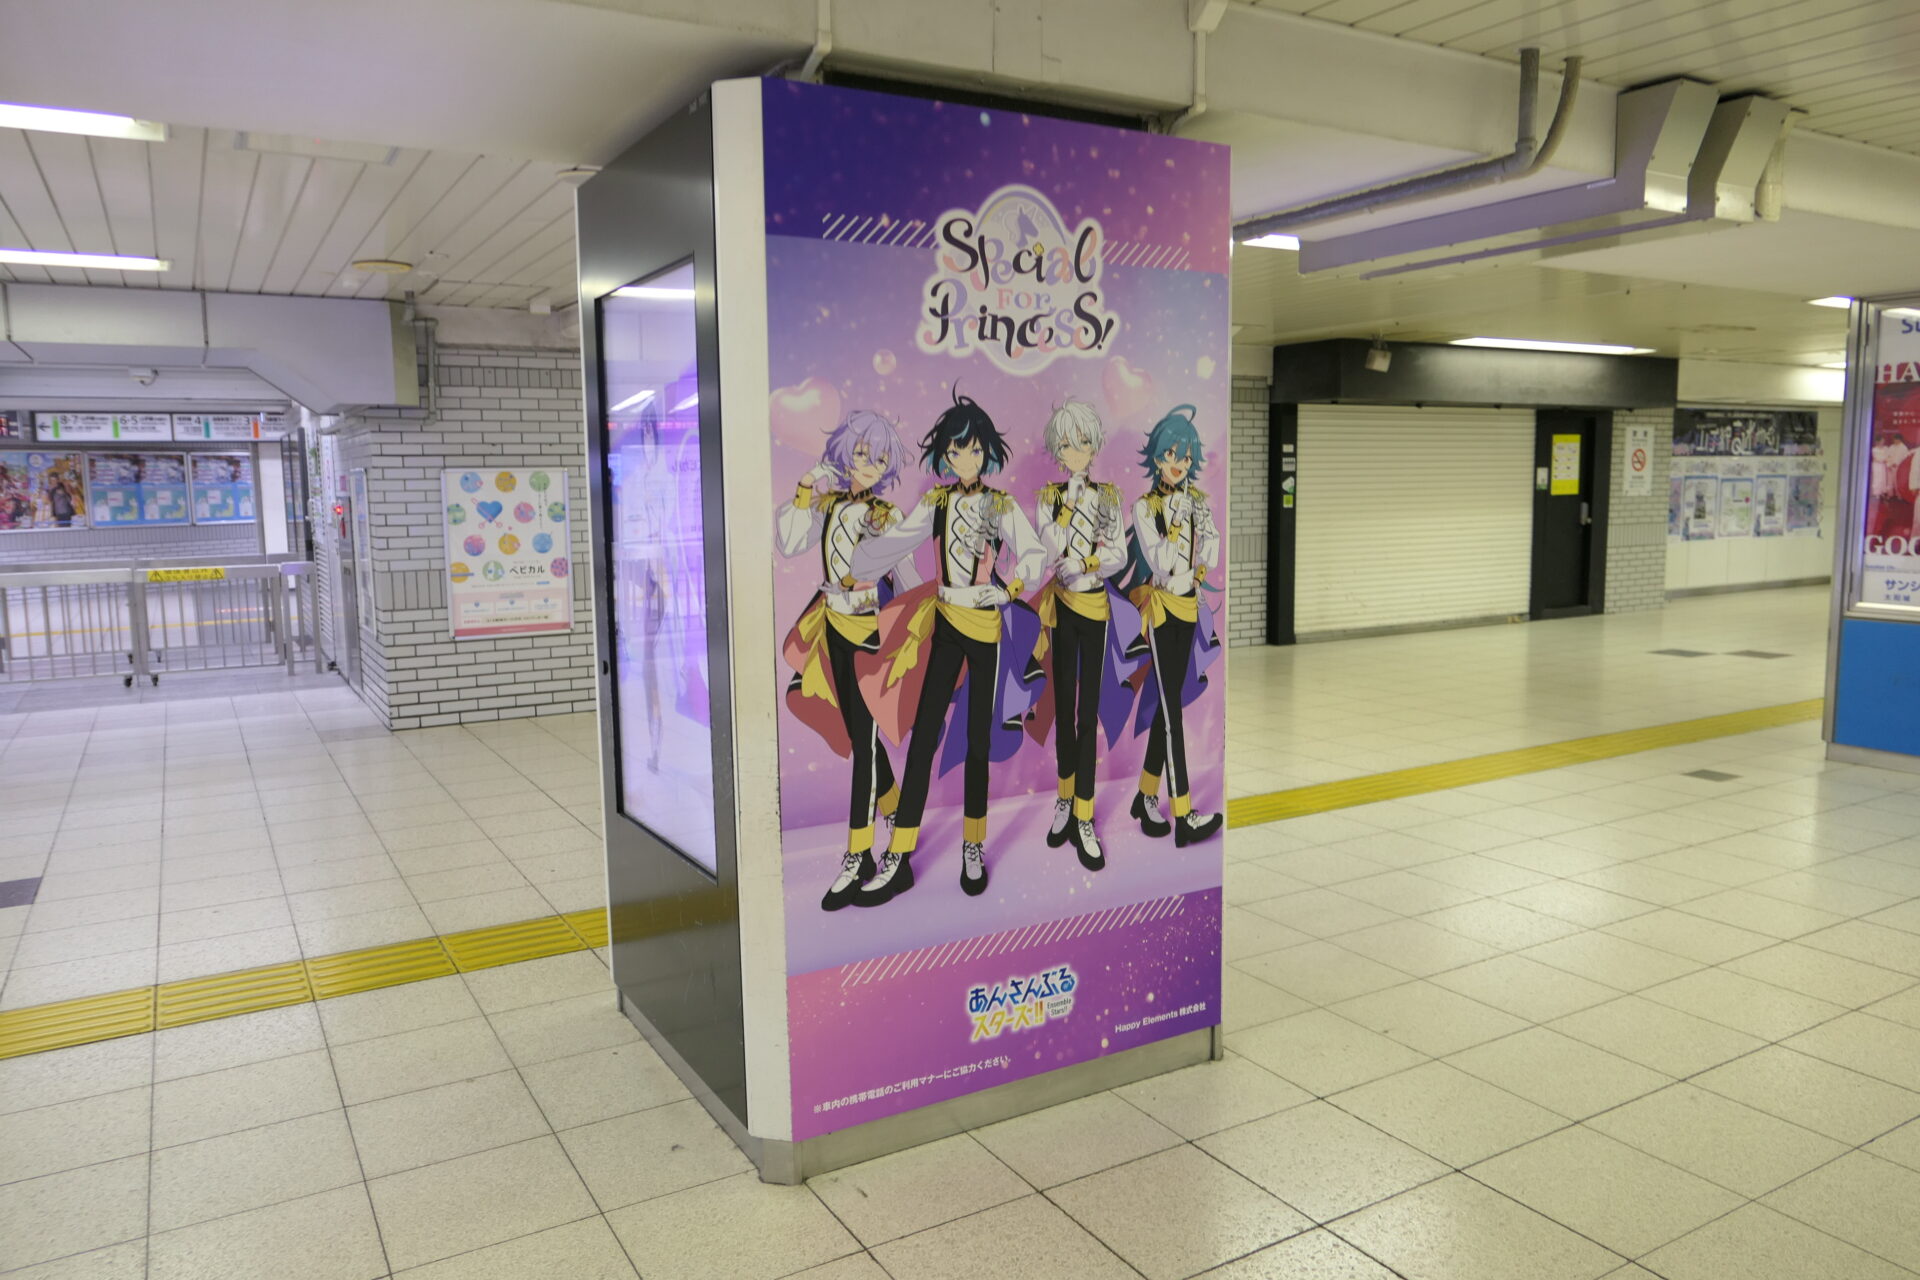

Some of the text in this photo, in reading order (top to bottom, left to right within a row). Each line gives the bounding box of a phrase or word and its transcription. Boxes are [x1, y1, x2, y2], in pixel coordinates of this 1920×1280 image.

[942, 217, 1097, 291] Special
[996, 287, 1052, 310] For
[969, 967, 1076, 1013] あんさんぶる
[1046, 997, 1072, 1009] Ensemble
[1115, 1001, 1207, 1033] Happy Elements 株式会社
